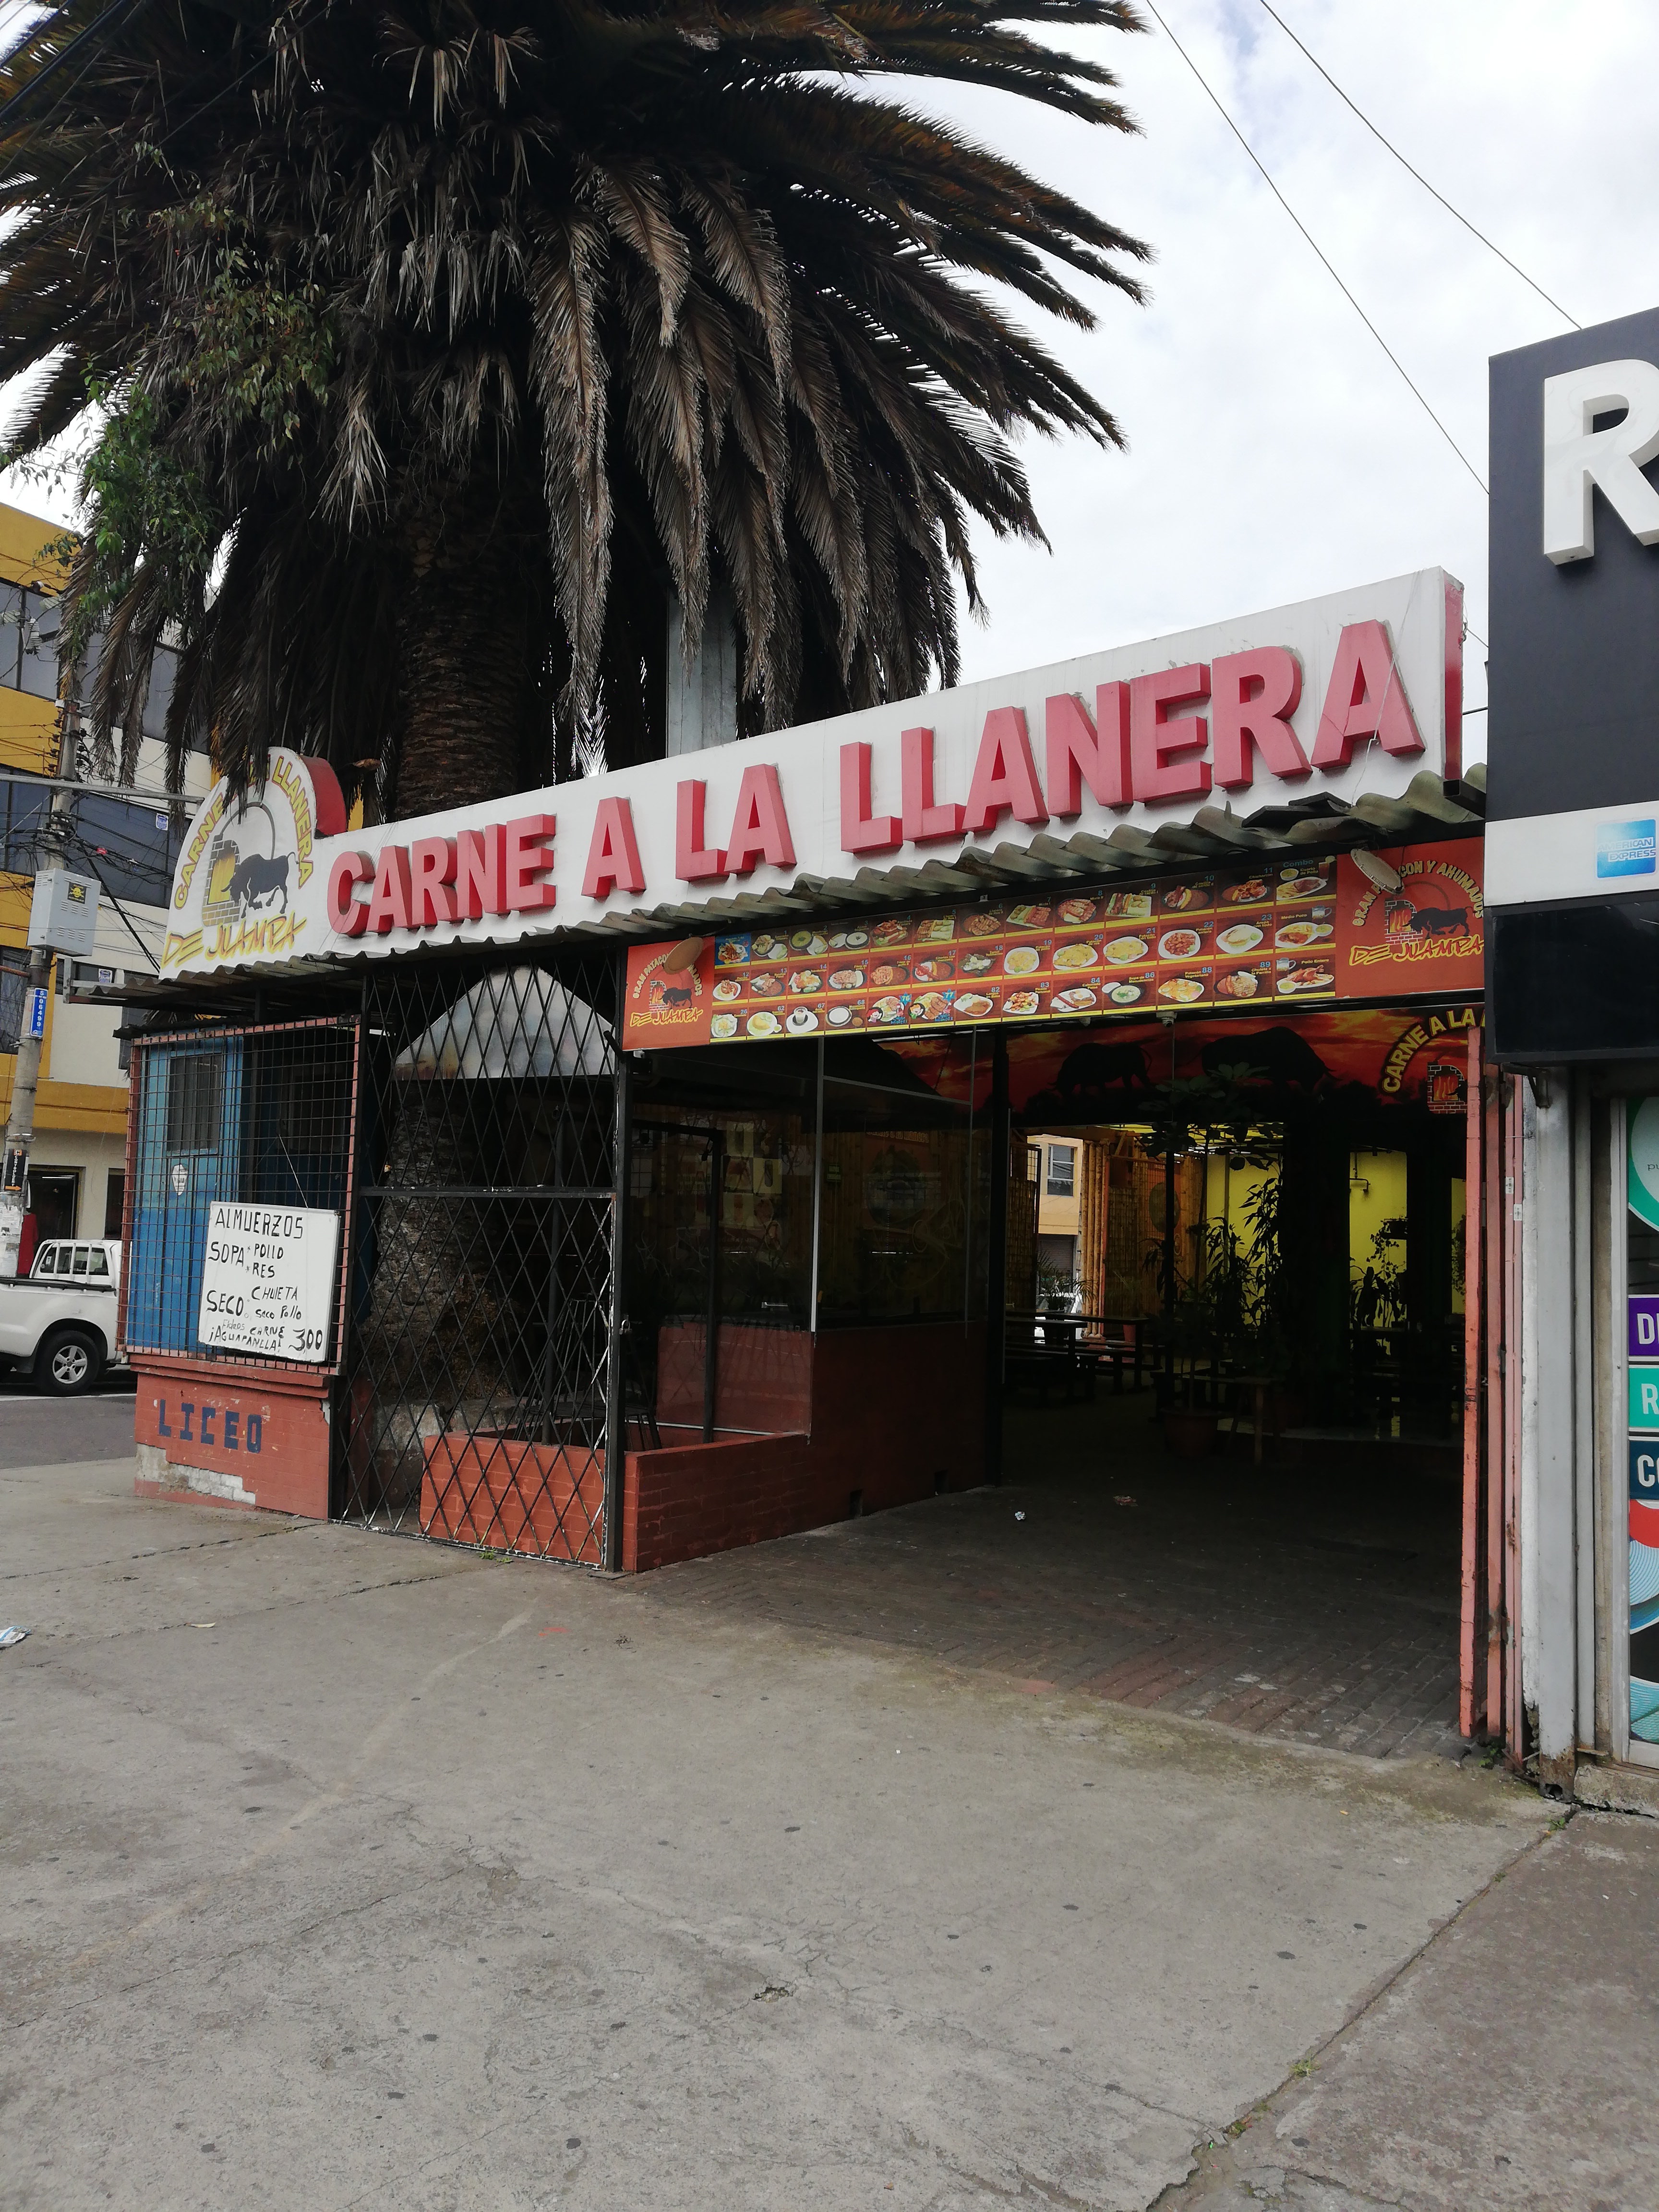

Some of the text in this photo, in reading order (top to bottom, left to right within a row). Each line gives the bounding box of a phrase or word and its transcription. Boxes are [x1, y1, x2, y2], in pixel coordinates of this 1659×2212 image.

[327, 619, 1425, 938] CARNE A LA LLANERA
[174, 755, 313, 910] CARNE LLANERA
[1598, 838, 1656, 862] AMERICAN EXPRESS
[1283, 859, 1314, 868] Combo
[1352, 890, 1377, 926] GRAN
[1426, 860, 1437, 873] Y
[1437, 862, 1484, 919] AHUMADOS
[161, 927, 204, 969] DE
[1349, 944, 1393, 966] DE
[633, 973, 647, 998] GRAN
[630, 1010, 652, 1027] DE
[1382, 1024, 1430, 1094] CARNE
[1429, 1015, 1447, 1036] A
[1447, 1008, 1476, 1030] LA
[215, 1208, 303, 1239] ALMUERZOS
[208, 1241, 245, 1267] SOPA
[252, 1262, 276, 1278] RES
[206, 1290, 244, 1317] SECO
[250, 1326, 285, 1339] CARNE
[158, 1399, 263, 1454] LICEO
